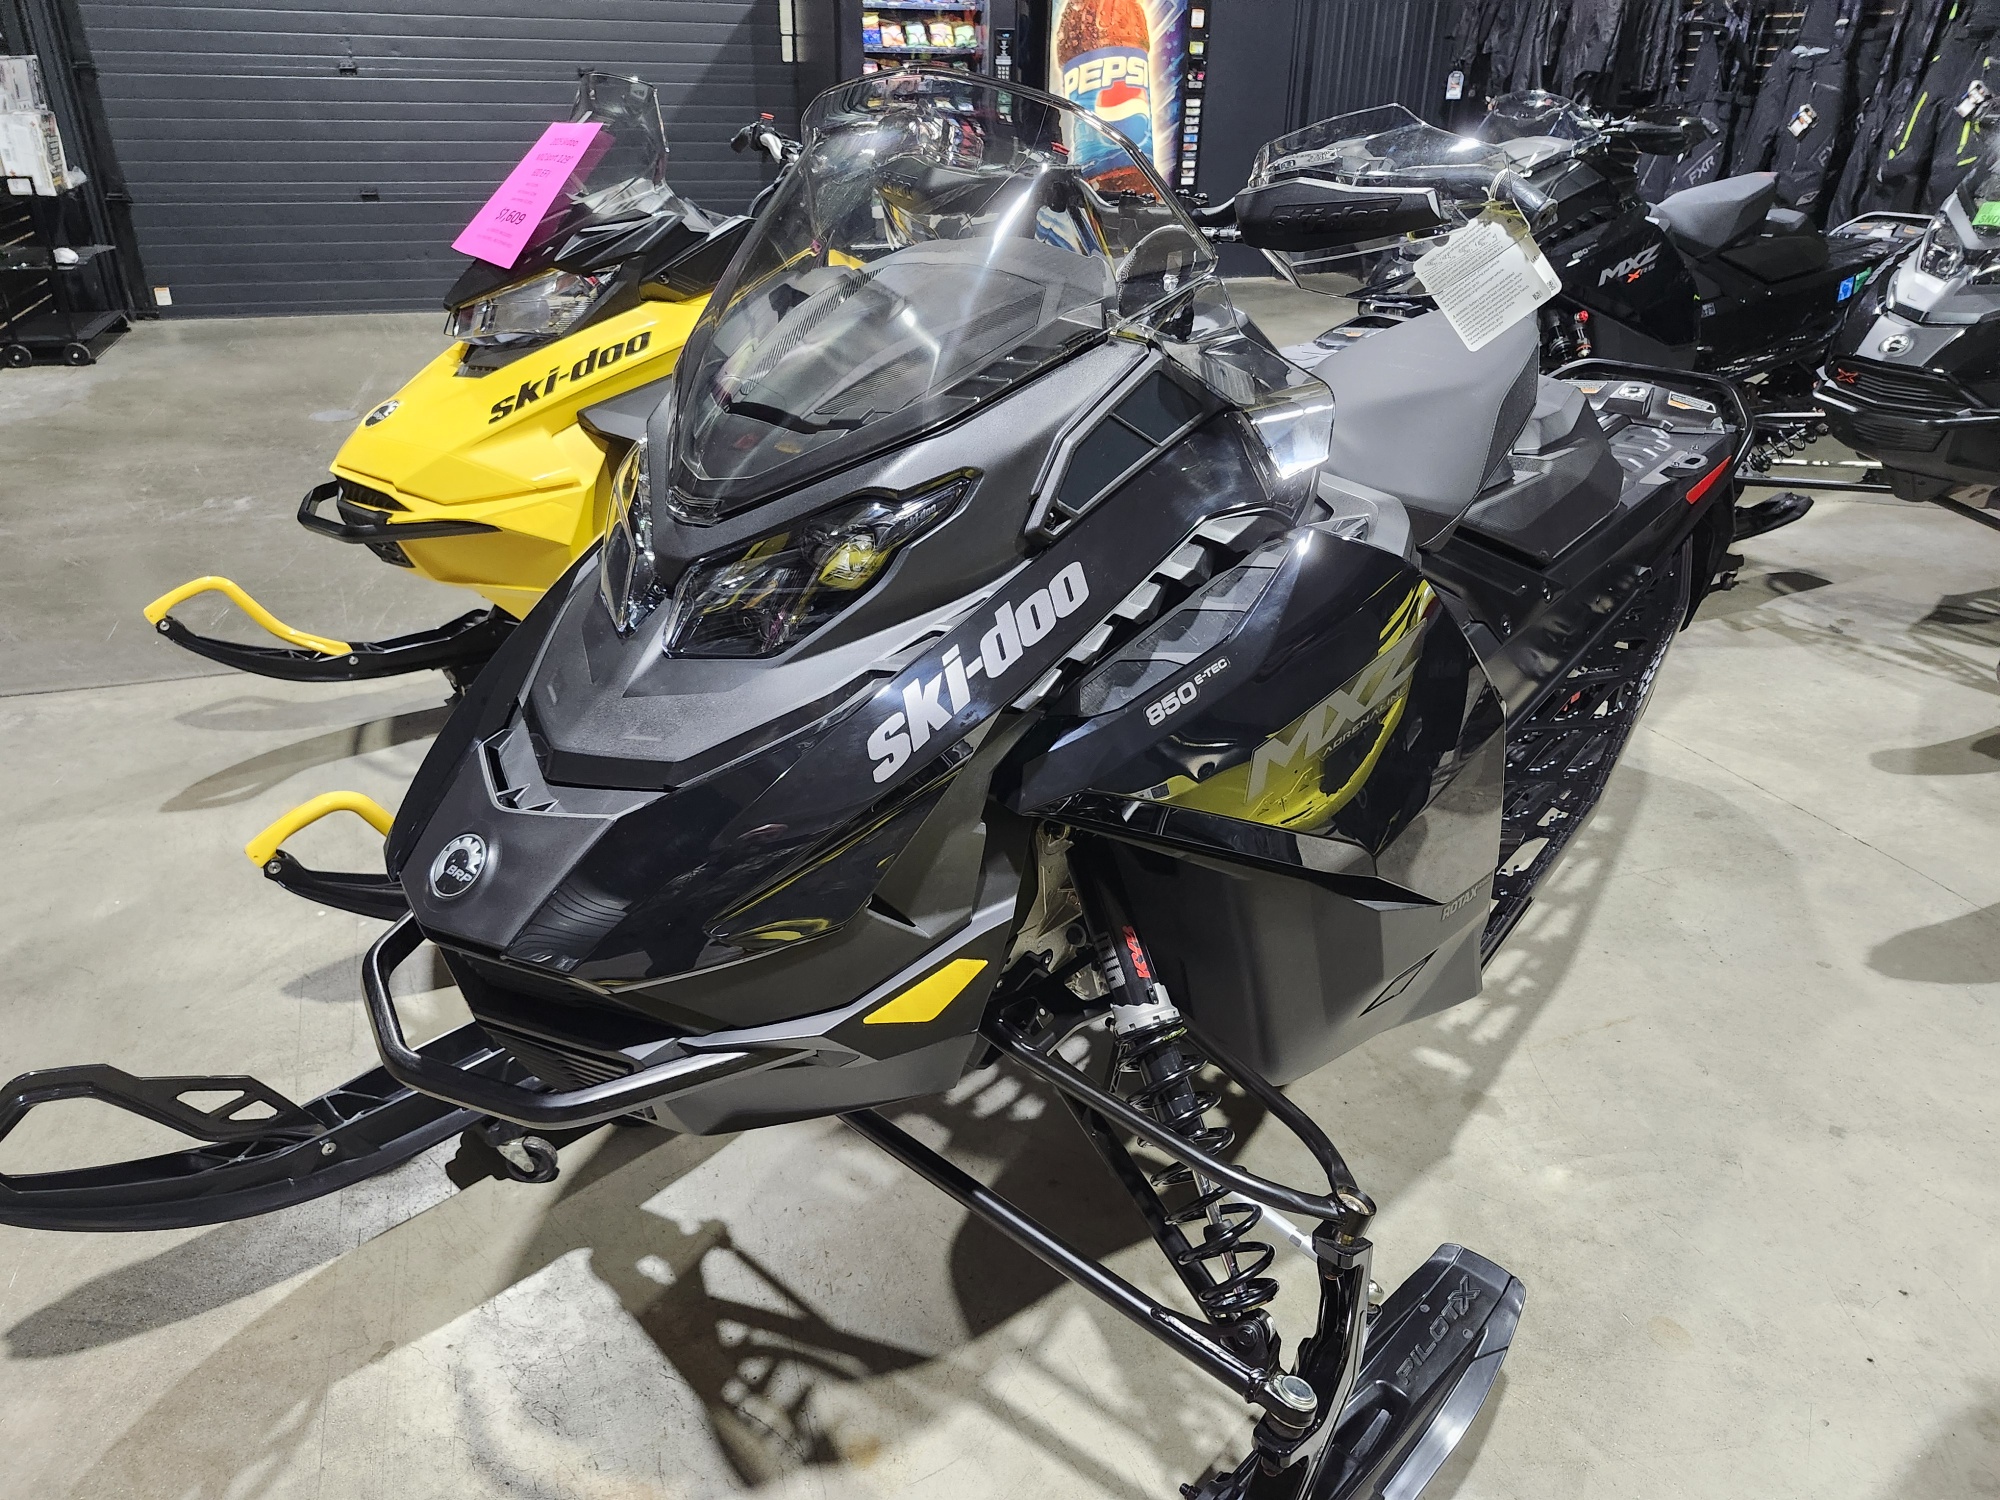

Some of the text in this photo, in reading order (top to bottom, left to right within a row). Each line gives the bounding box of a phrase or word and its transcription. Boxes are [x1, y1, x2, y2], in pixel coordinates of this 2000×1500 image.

[1064, 56, 1148, 99] PEPSI
[1688, 154, 1716, 185] FXR
[495, 207, 526, 225] $7,609
[1598, 242, 1662, 287] MXZ
[488, 330, 652, 425] ski-doo
[904, 503, 937, 531] ski-doo
[866, 561, 1090, 784] ski-doo
[1145, 658, 1228, 726] 850 E-TEC
[1248, 623, 1426, 801] MXZ
[1323, 684, 1408, 757] ADRENALINE
[446, 864, 473, 882] BRP
[1441, 885, 1478, 921] ROTAX
